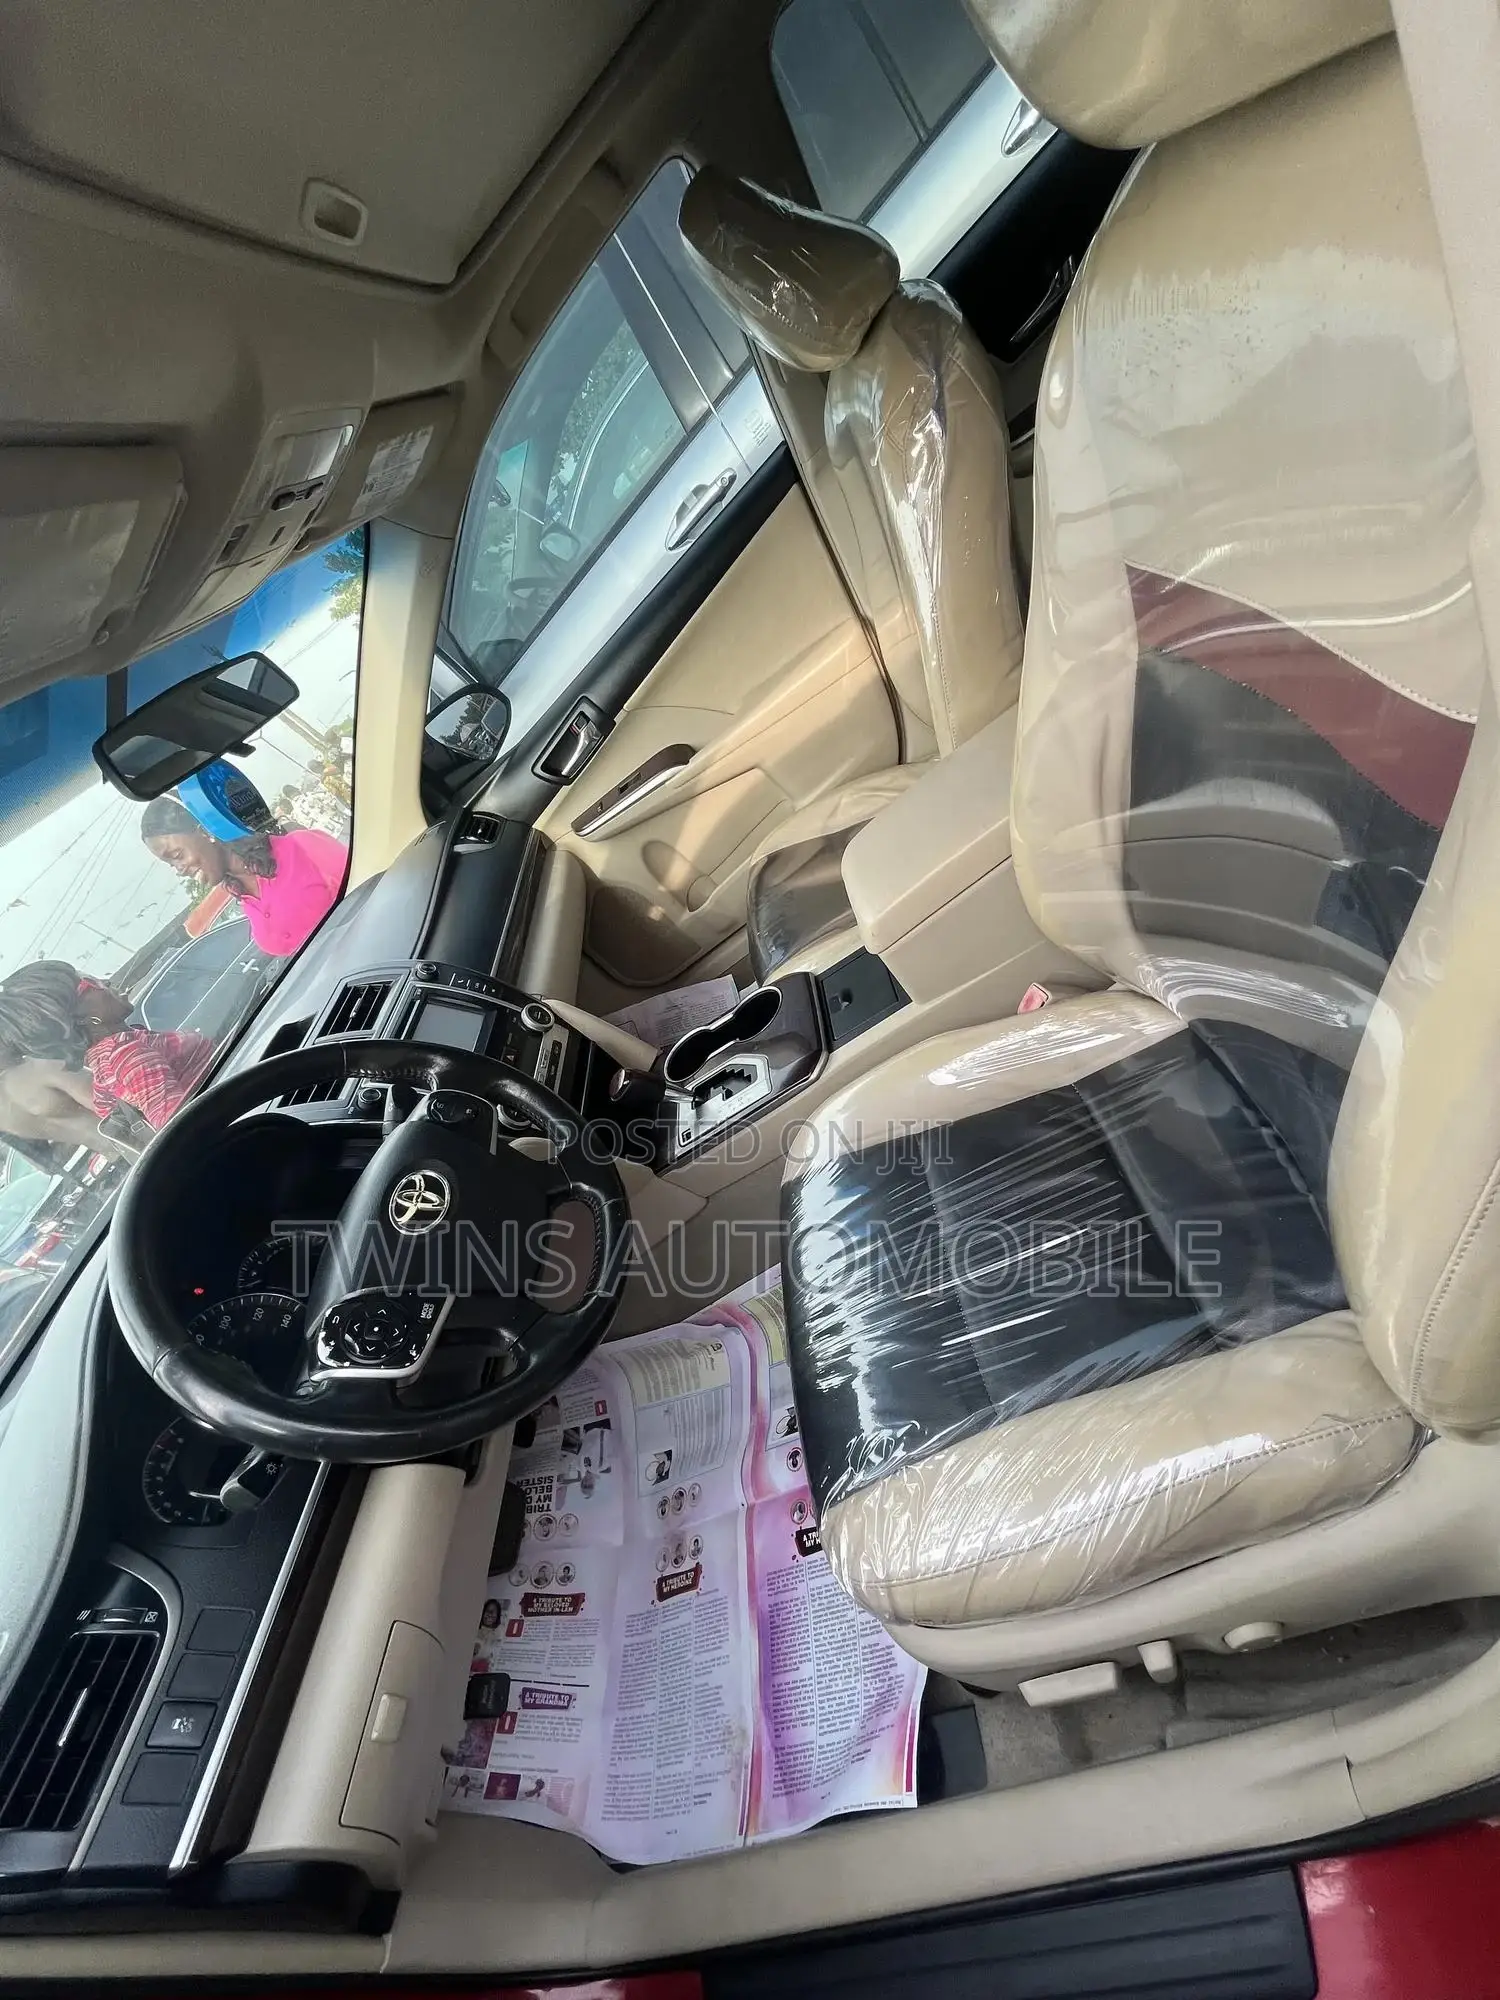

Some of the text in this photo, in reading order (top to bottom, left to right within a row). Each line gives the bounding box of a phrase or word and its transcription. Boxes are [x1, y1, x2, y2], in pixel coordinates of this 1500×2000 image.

[252, 1307, 265, 1321] 120
[219, 1315, 232, 1330] 100
[280, 1314, 292, 1328] 140
[524, 1485, 552, 1495] BELO
[536, 1494, 552, 1503] MY
[526, 1504, 552, 1514] TRIB
[808, 1531, 819, 1540] TRI
[805, 1539, 814, 1548] MY
